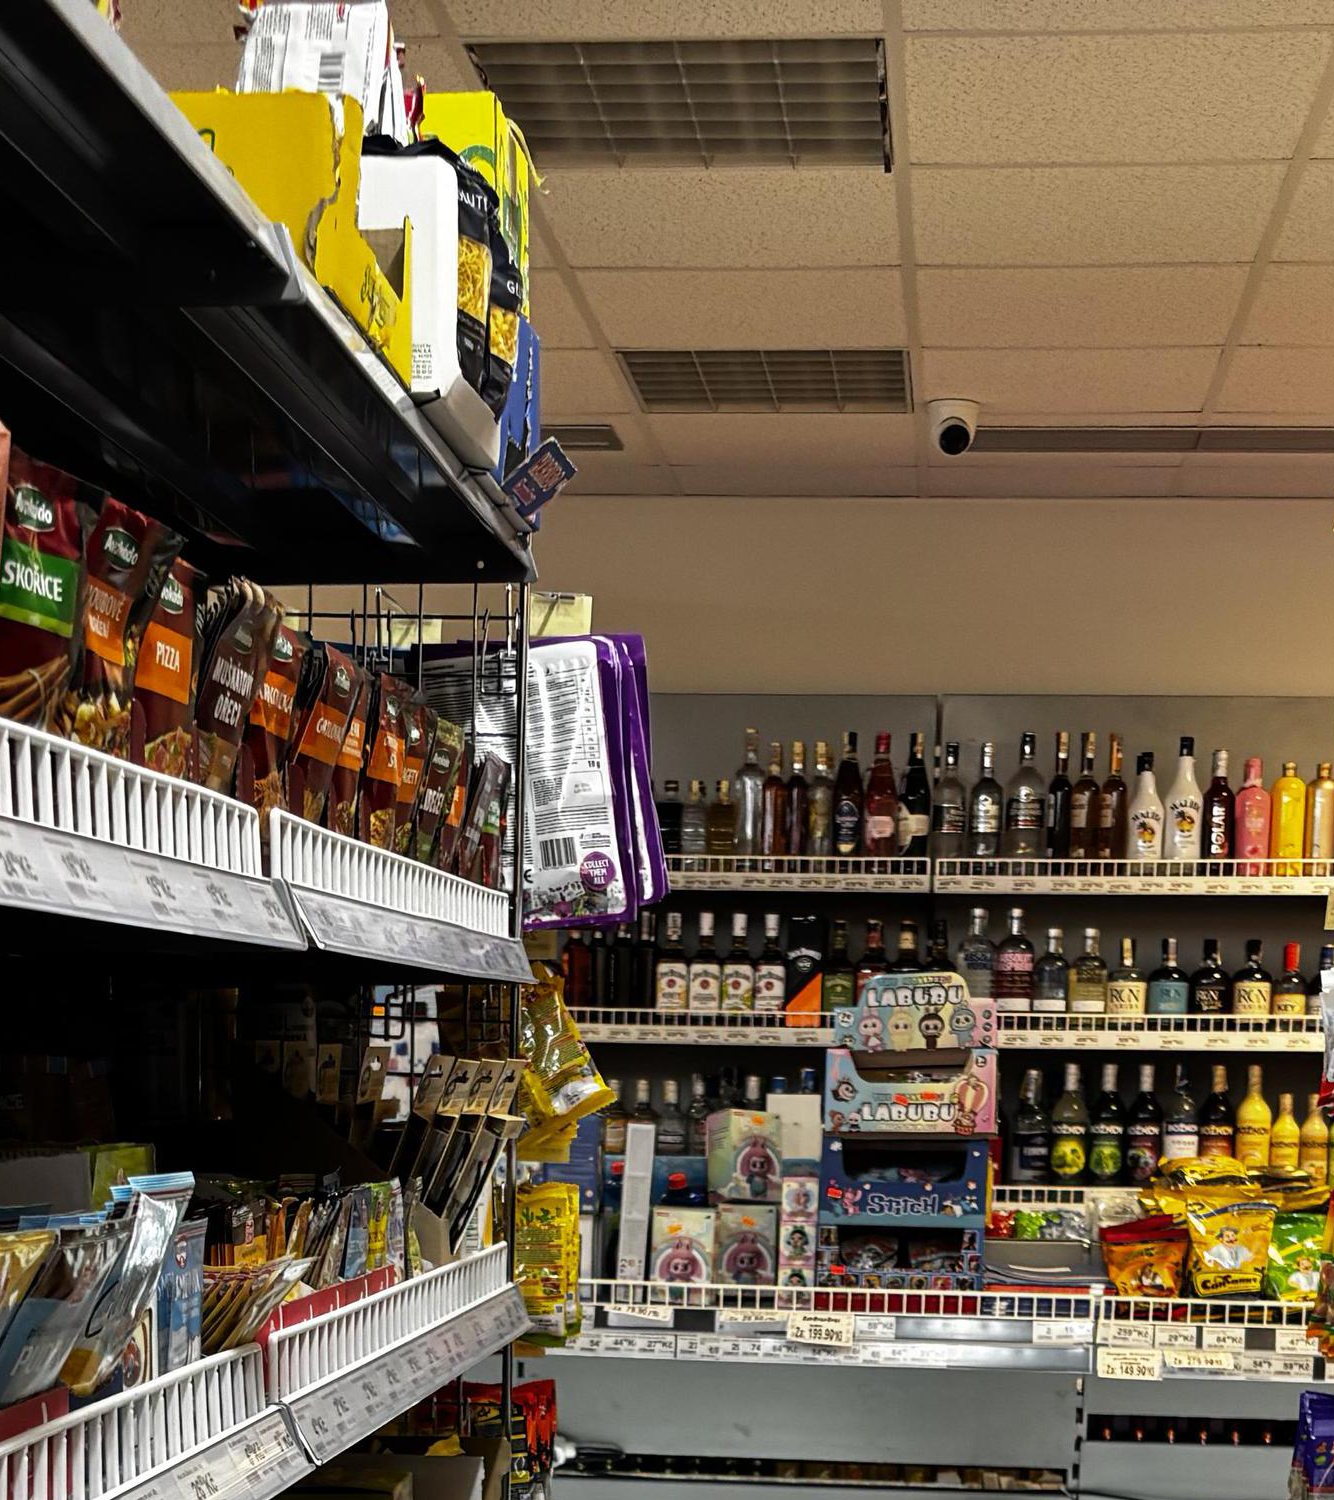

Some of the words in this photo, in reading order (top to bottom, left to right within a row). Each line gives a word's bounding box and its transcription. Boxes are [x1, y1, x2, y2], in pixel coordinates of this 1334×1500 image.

[1, 559, 63, 604] SKOŘICE
[155, 639, 180, 673] PIZZA
[1211, 806, 1227, 855] POLAR
[867, 985, 964, 1008] LABUBU
[860, 1103, 957, 1122] LABUBU
